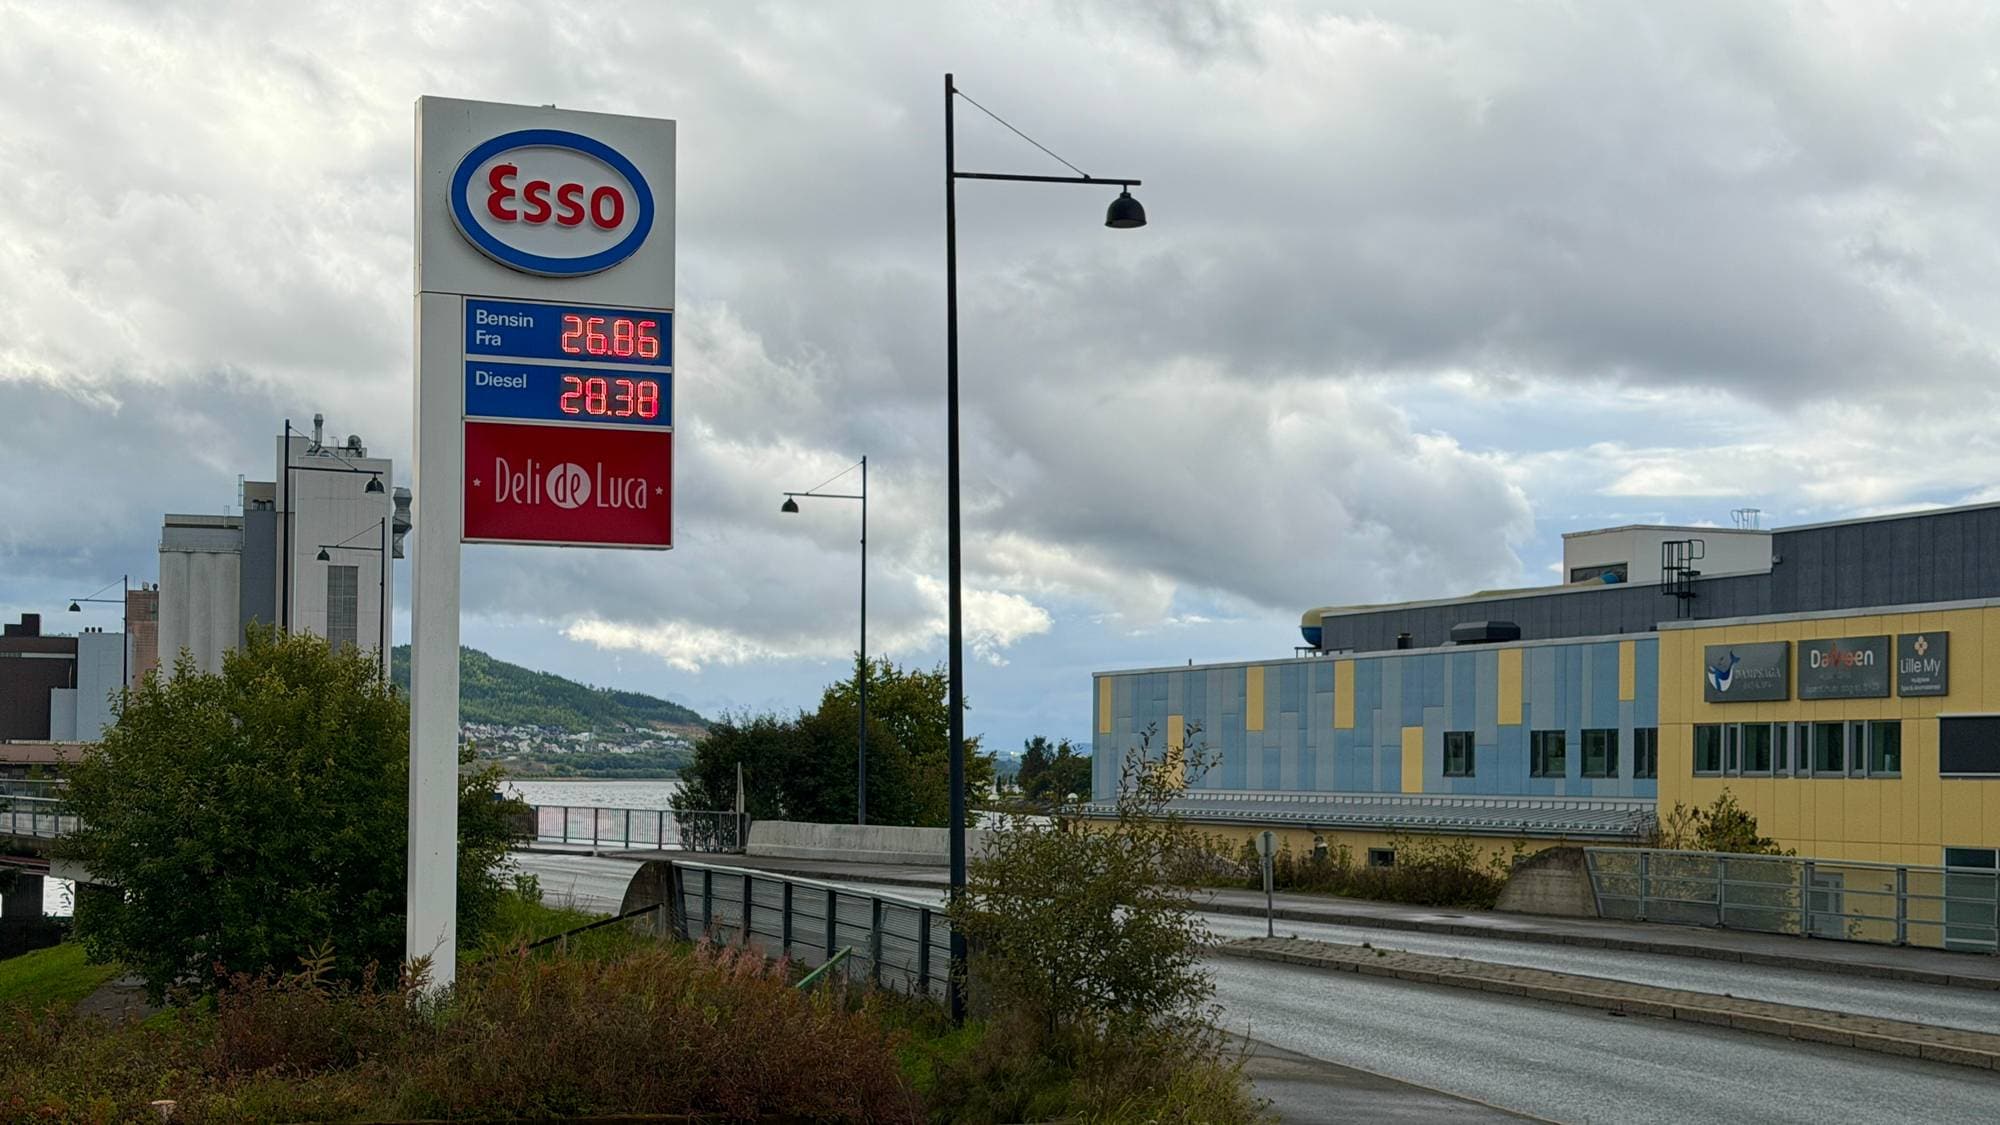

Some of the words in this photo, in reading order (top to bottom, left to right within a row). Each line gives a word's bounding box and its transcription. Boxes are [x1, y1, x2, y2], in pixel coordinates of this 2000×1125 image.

[487, 164, 625, 231] Esso
[475, 309, 534, 328] Bensin
[475, 330, 501, 347] Fra
[561, 315, 659, 358] 26.86
[475, 371, 527, 389] Diesel
[560, 376, 659, 418] 28.38
[495, 457, 540, 504] Deli
[552, 463, 586, 508] de
[597, 462, 647, 509] Luca
[1900, 658, 1922, 674] Lille
[1923, 657, 1941, 676] My
